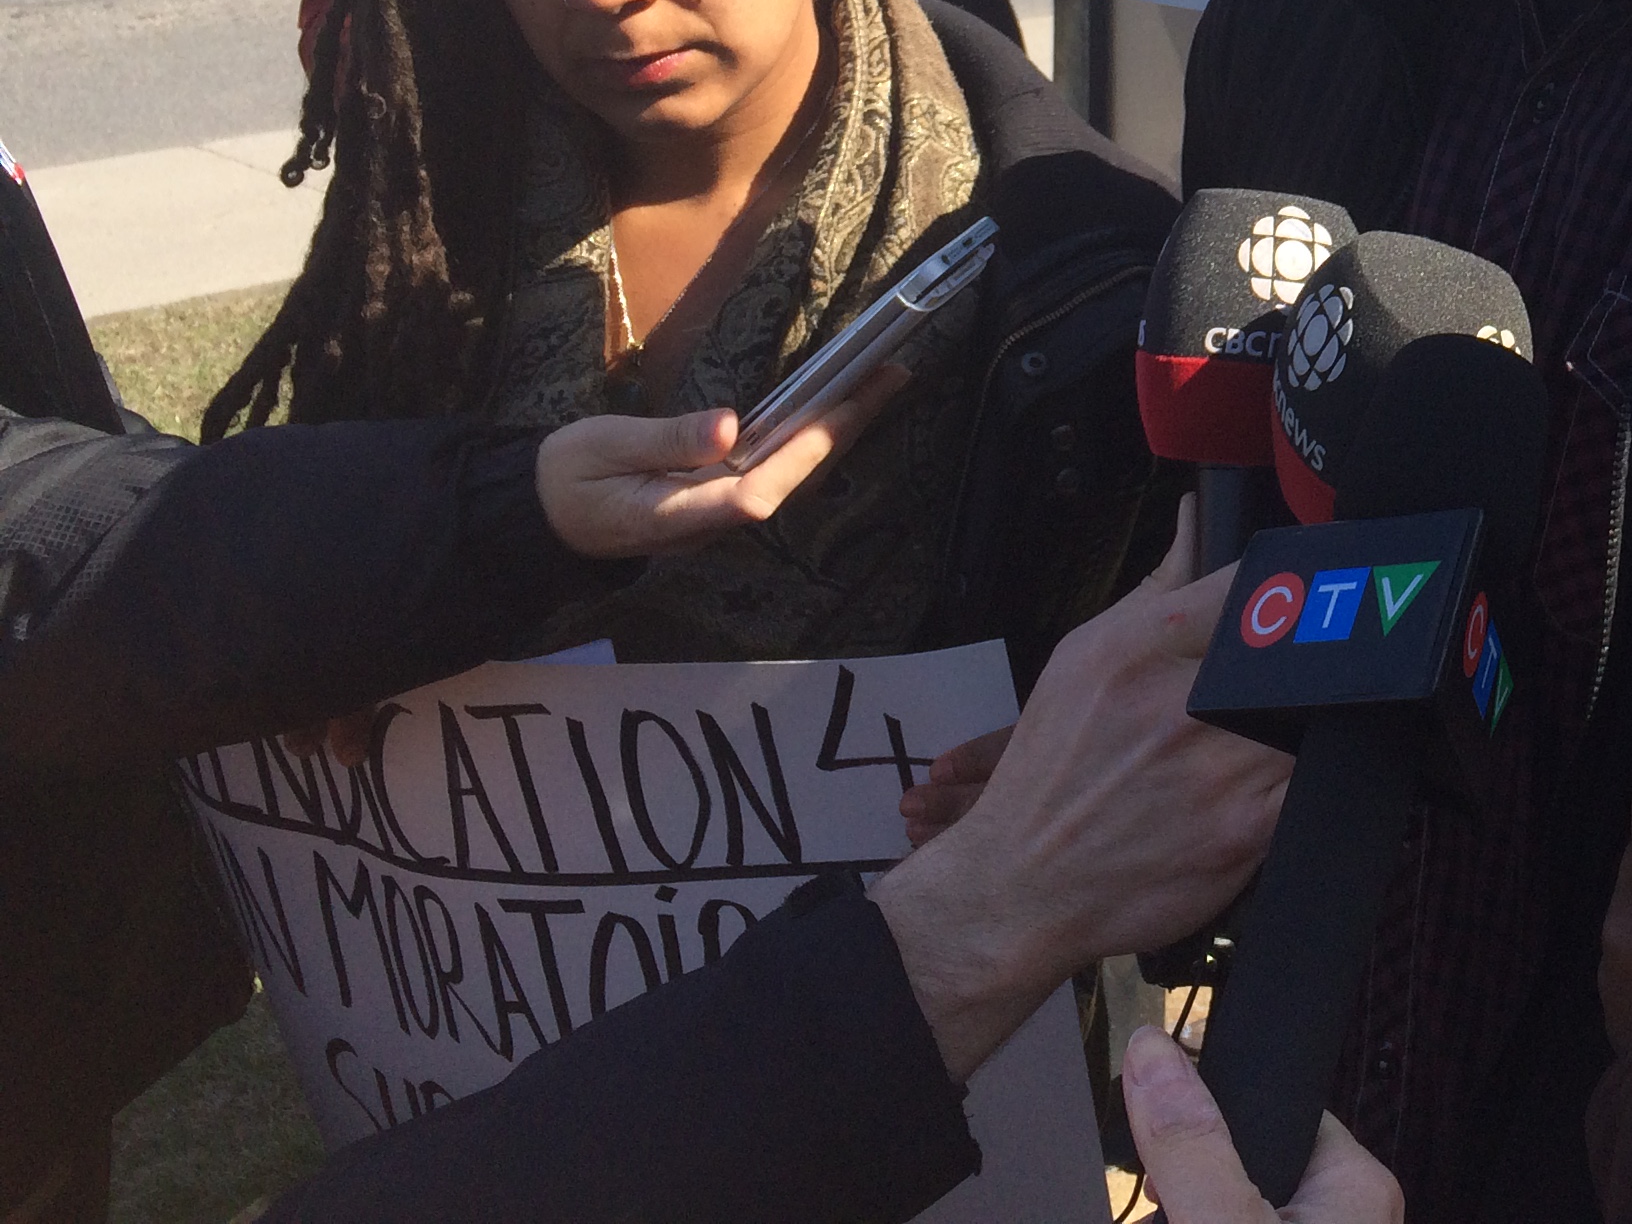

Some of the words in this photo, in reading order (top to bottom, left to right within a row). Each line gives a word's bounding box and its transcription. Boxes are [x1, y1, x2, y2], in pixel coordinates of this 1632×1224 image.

[1248, 571, 1425, 638] CTV
[1467, 603, 1510, 718] CTV
[815, 663, 934, 796] 4
